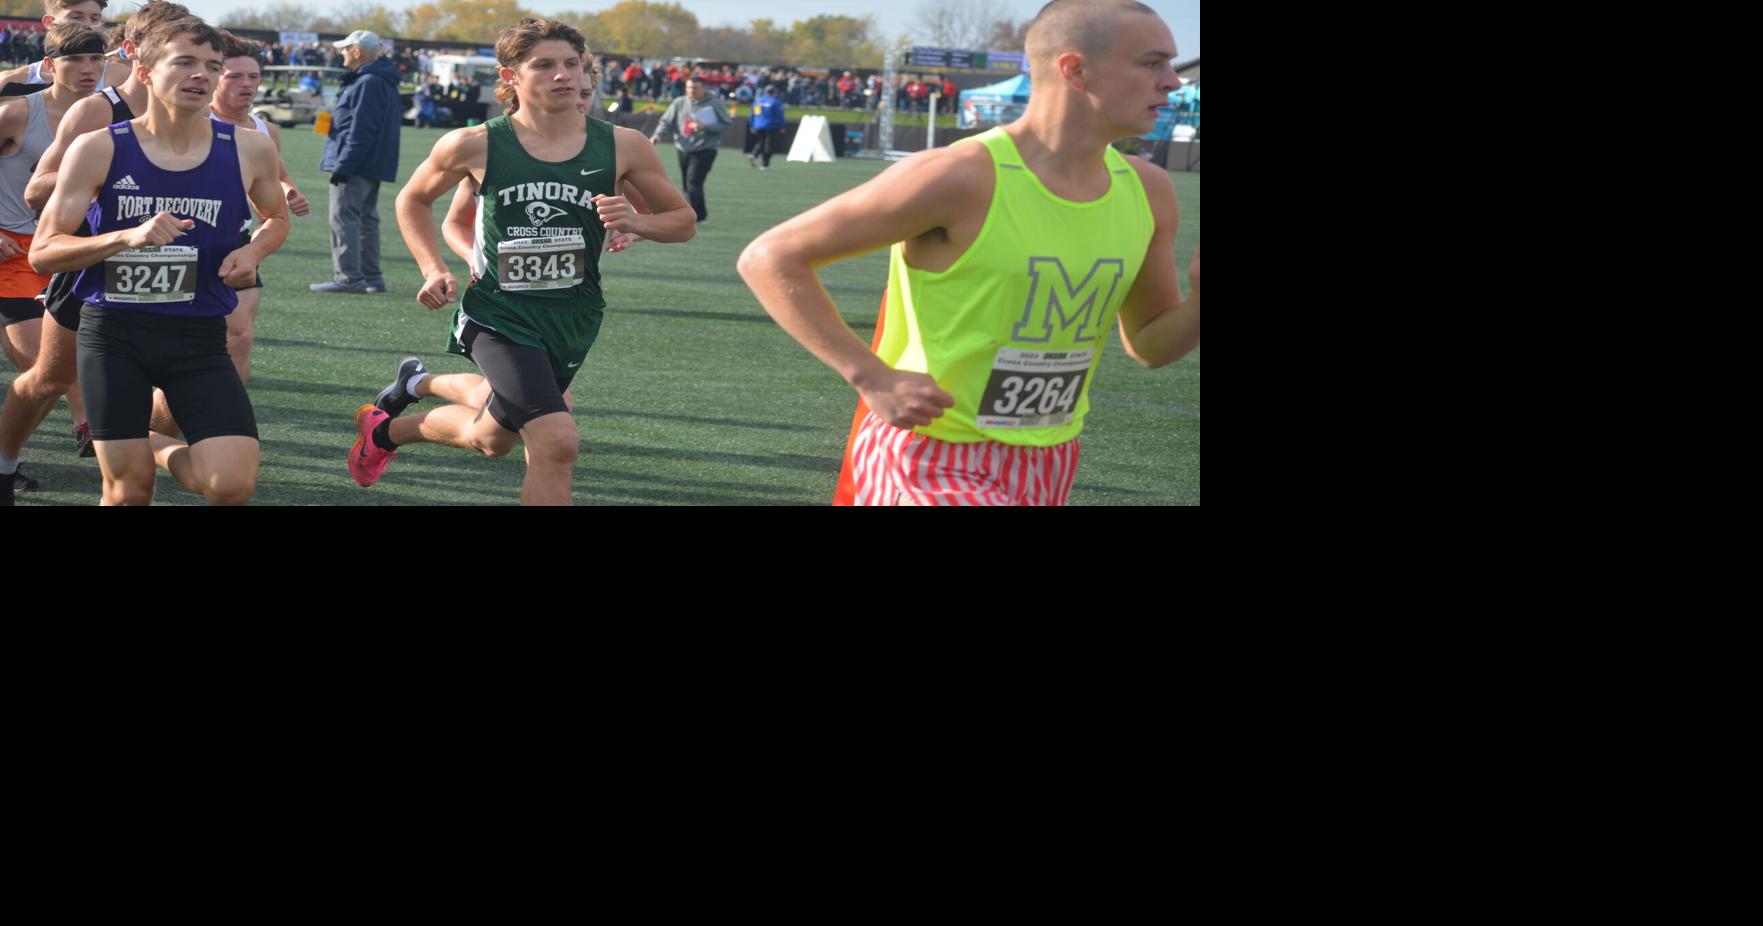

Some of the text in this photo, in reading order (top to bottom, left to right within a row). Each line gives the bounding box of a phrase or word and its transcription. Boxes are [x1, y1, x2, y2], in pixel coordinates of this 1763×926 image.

[498, 182, 593, 210] TINORA
[116, 195, 222, 228] FORT RECOVERY
[507, 226, 584, 238] CROSS COUNTRY
[116, 265, 187, 293] 3247
[508, 253, 576, 281] 3343
[1011, 256, 1124, 343] M
[993, 375, 1081, 415] 3264
